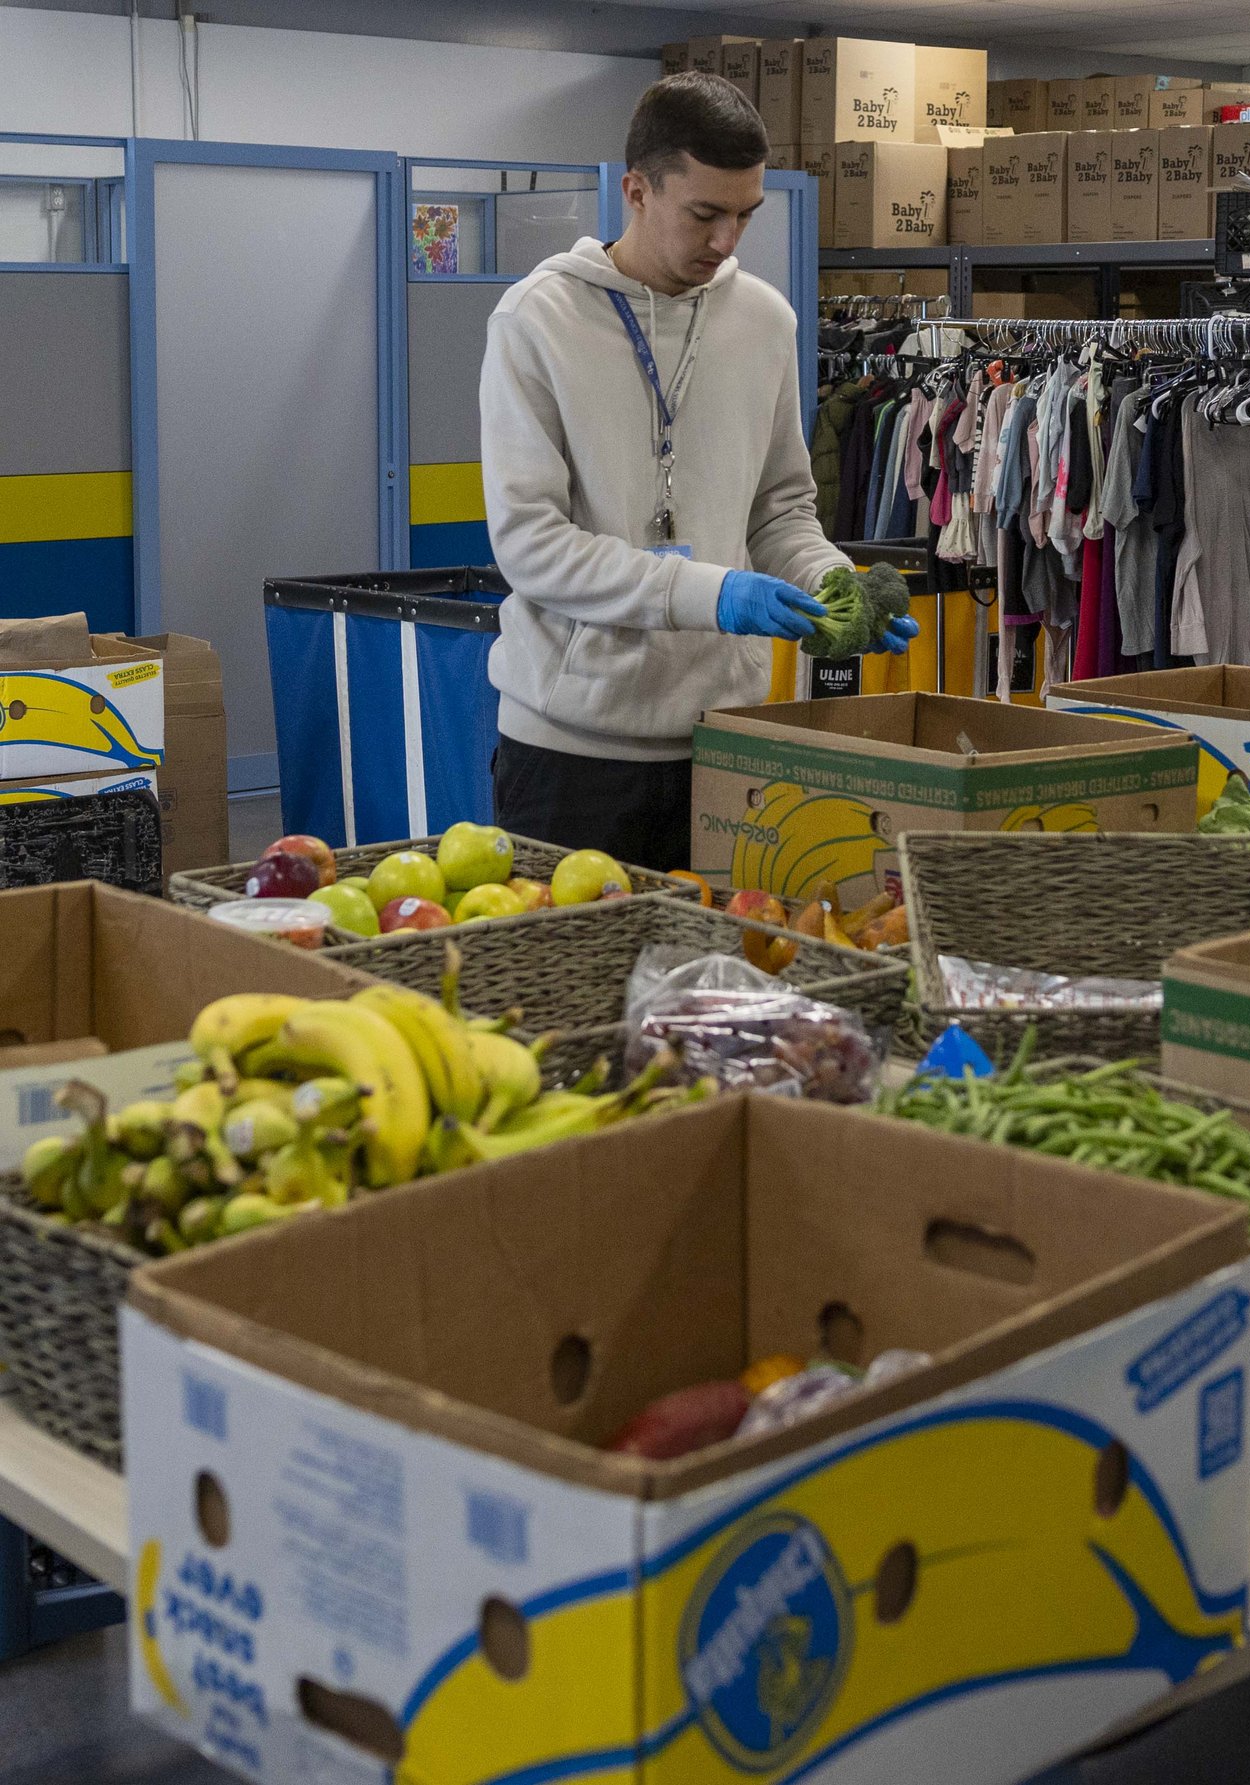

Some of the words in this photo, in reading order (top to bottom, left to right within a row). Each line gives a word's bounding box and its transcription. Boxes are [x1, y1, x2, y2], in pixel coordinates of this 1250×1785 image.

[853, 98, 885, 114] Baby
[927, 103, 957, 119] Baby
[1118, 101, 1134, 110] Baby
[1162, 102, 1180, 111] Baby
[842, 161, 860, 170] Baby
[1075, 161, 1097, 173] Baby
[1115, 158, 1141, 171] Baby
[1162, 157, 1190, 171] Baby
[1216, 154, 1245, 167] Baby
[989, 165, 1011, 176] Baby
[1027, 162, 1048, 174] Baby
[948, 177, 969, 189] Baby
[892, 202, 922, 219] Baby
[819, 669, 853, 681] ULINE
[735, 754, 784, 775] CERTIFIED
[793, 765, 844, 788] BANANAS
[125, 778, 143, 790] CLASS
[846, 774, 896, 796] ORGANIC
[1036, 780, 1087, 801] ORGANIC
[1090, 774, 1142, 795] CERTIFIED
[898, 782, 957, 805] CERTIFIED
[976, 787, 1034, 807] BANANAS
[700, 812, 779, 845] ORGANIC
